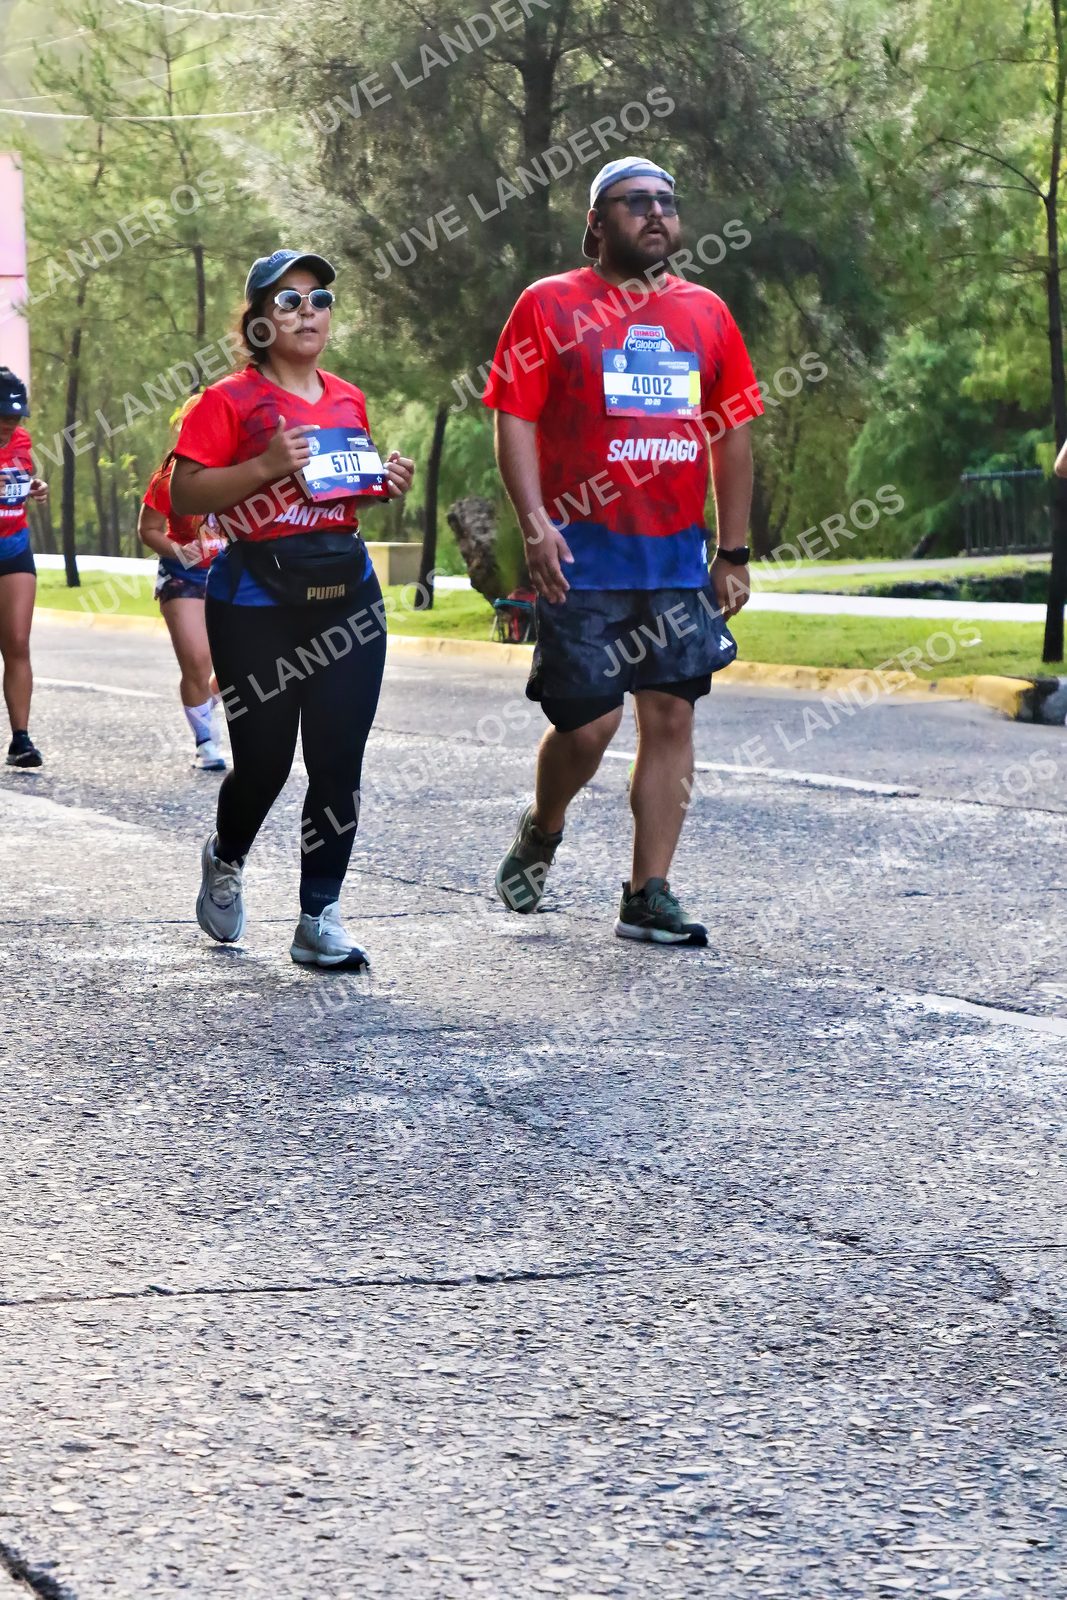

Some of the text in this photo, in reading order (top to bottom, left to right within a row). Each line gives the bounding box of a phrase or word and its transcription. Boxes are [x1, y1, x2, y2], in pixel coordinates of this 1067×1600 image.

[635, 339, 661, 349] Global
[632, 376, 672, 395] 4002
[607, 438, 698, 462] SANTIAGO
[331, 453, 361, 473] 5717
[307, 584, 345, 600] PUMA
